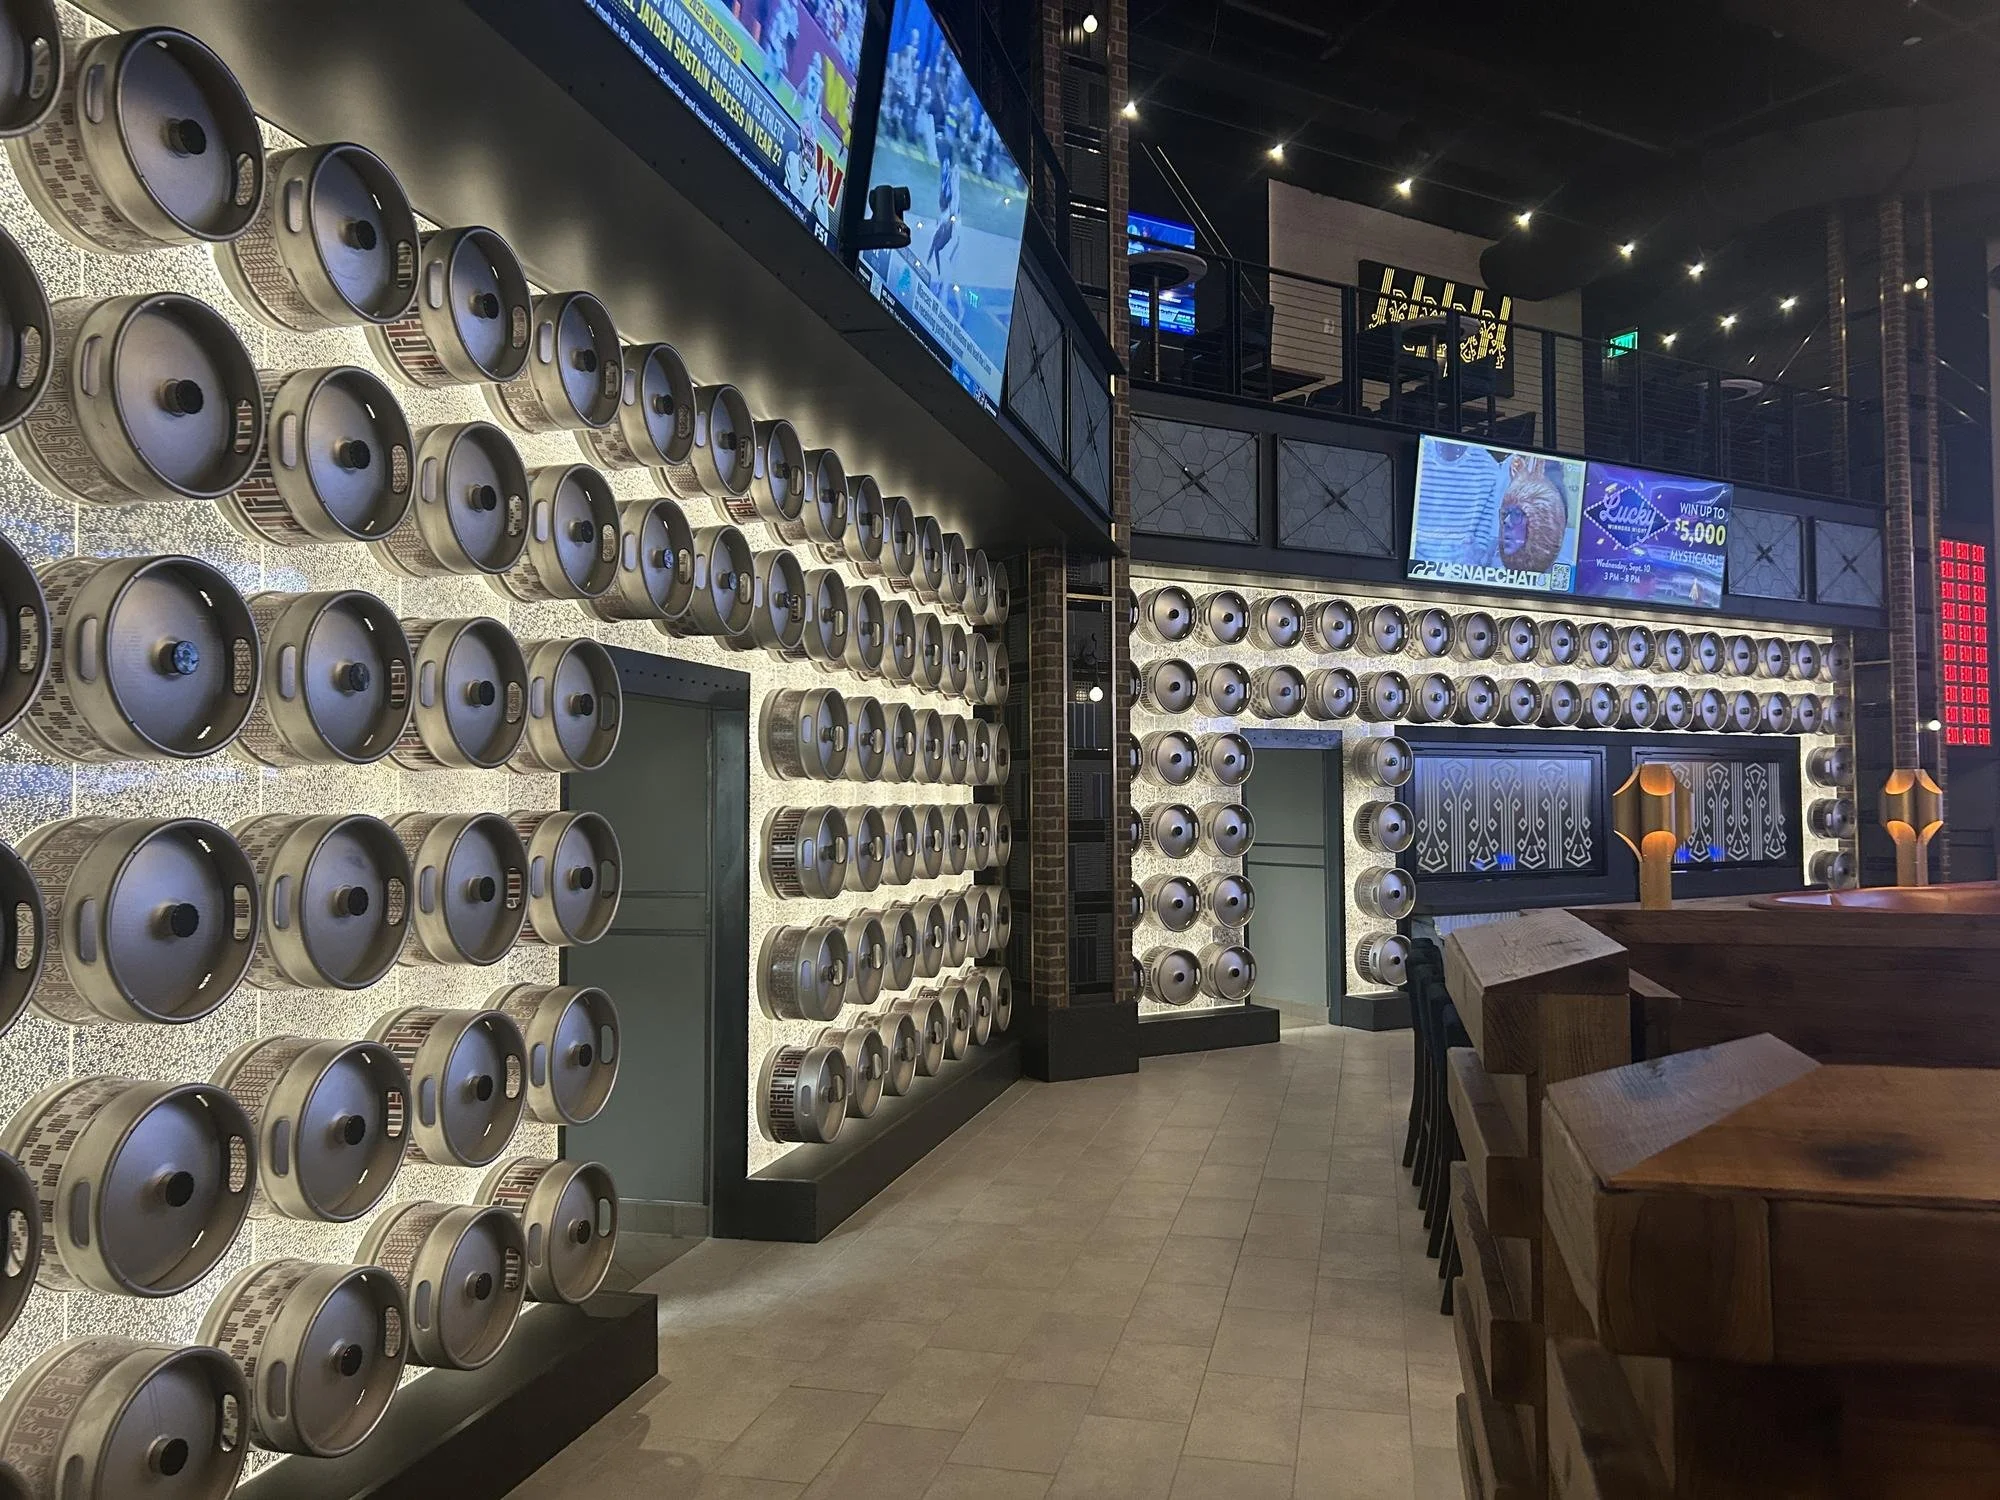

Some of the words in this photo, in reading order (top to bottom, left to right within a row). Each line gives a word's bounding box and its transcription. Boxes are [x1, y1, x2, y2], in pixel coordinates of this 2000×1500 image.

[620, 26, 630, 43] 60
[636, 0, 673, 52] JAYDEN
[674, 36, 711, 92] SUSTAIN
[710, 76, 745, 128] SUCCESS
[744, 113, 755, 138] IN
[754, 122, 773, 158] YEAR
[663, 0, 692, 41] RANKED
[728, 66, 744, 101] EVER
[744, 81, 753, 108] BY
[751, 91, 763, 120] THE
[761, 104, 786, 145] ATHLETIC
[814, 221, 829, 246] FS1
[1599, 491, 1656, 543] Lucky
[1680, 501, 1699, 517] WIN
[1700, 505, 1712, 518] UP
[1713, 507, 1725, 520] TO
[1675, 517, 1727, 548] $5,000
[1451, 563, 1538, 587] SNAPCHAT
[1596, 558, 1628, 573] Wednesday,
[1629, 562, 1643, 574] Sept.
[1609, 572, 1620, 582] PM
[1630, 574, 1641, 584] PM
